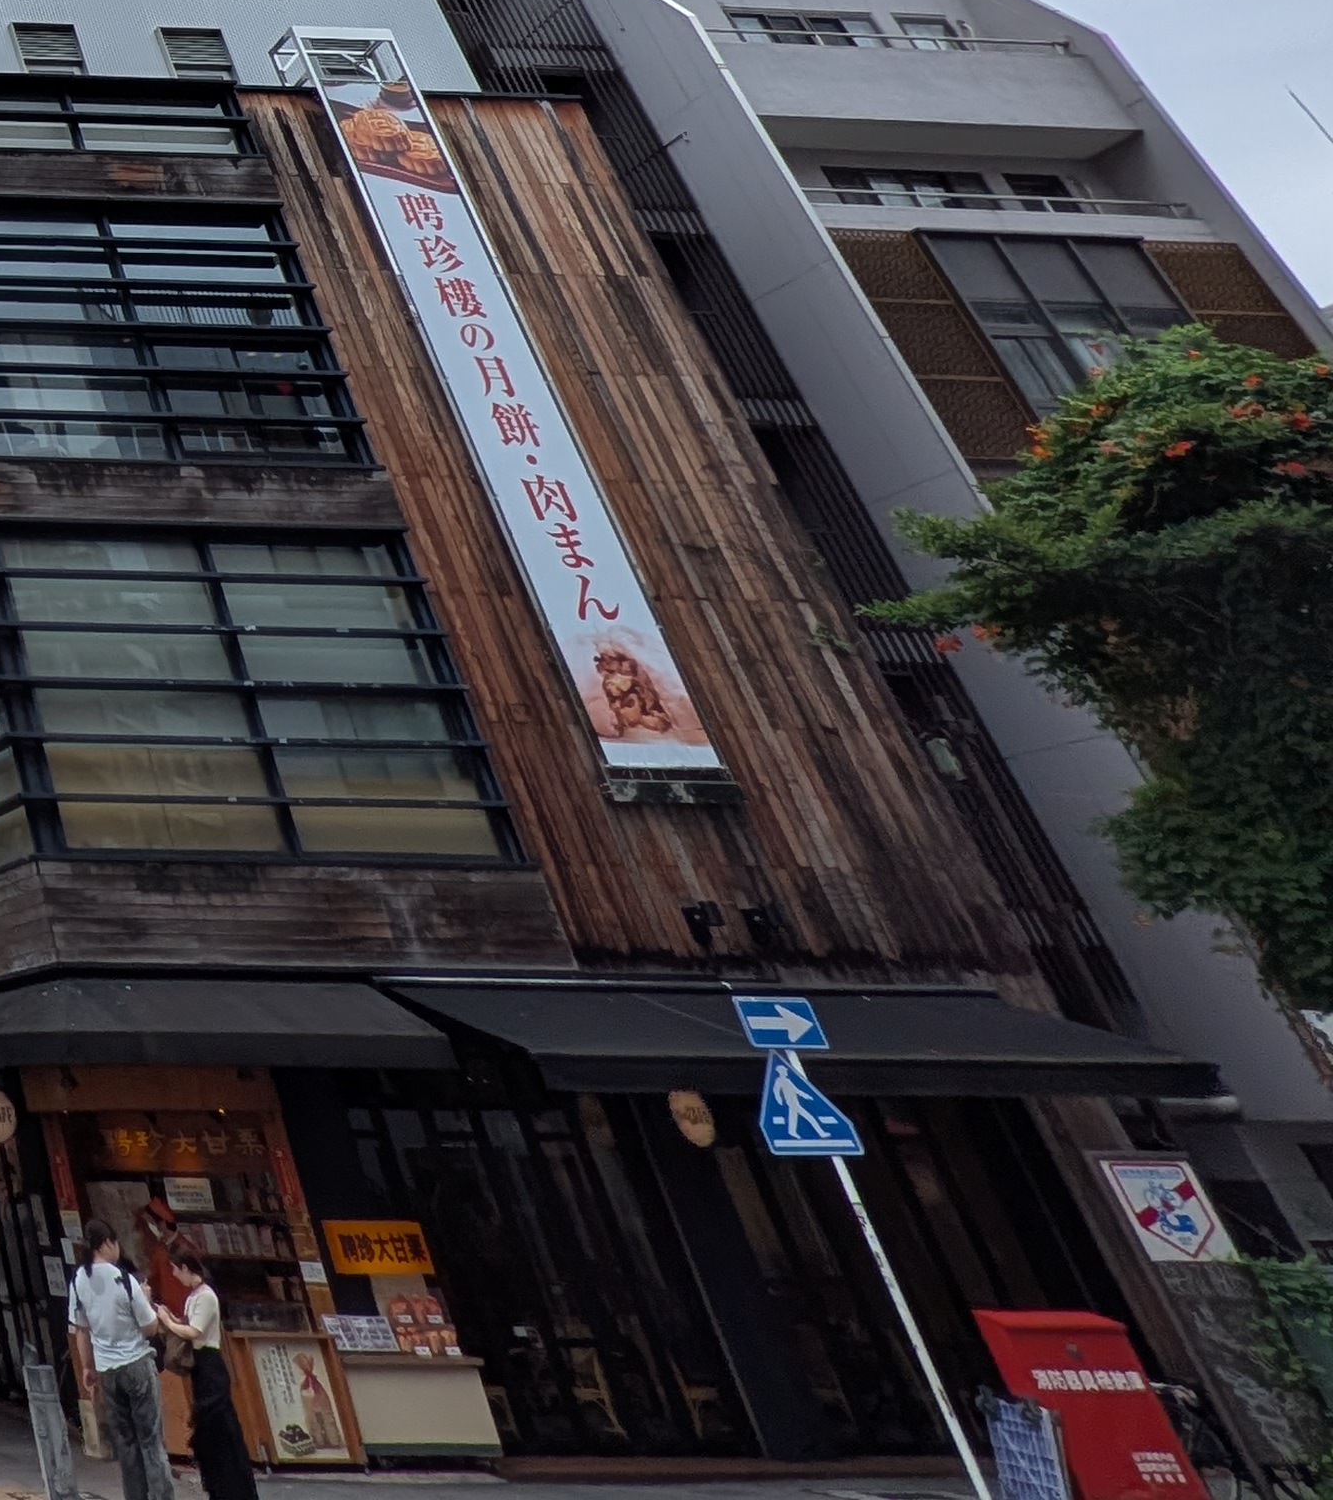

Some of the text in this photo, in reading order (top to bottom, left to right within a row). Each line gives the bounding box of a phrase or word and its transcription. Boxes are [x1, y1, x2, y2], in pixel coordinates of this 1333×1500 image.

[394, 192, 620, 622] 聘珍樓の月餅・肉まん
